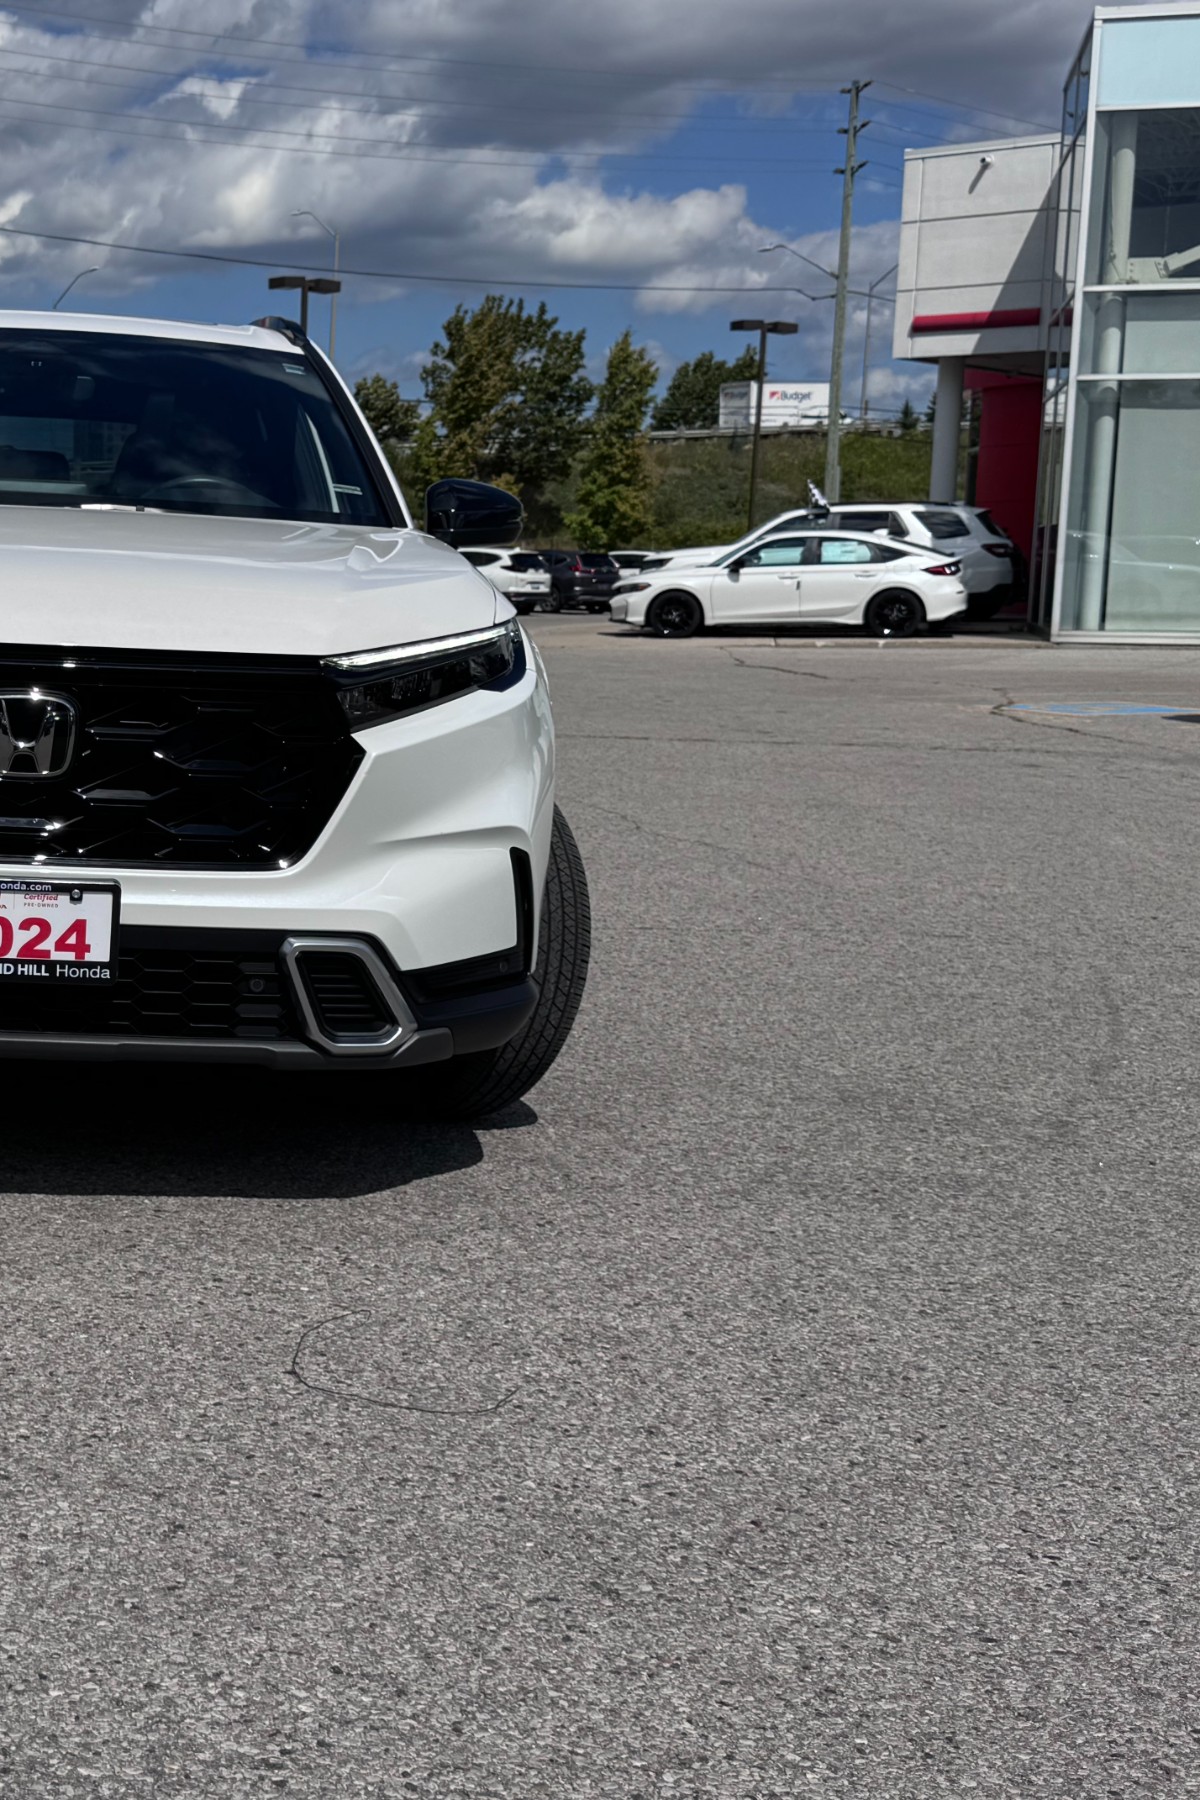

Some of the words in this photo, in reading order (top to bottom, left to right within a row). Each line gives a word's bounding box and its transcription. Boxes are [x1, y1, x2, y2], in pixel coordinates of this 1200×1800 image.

[781, 390, 812, 403] Budget
[24, 893, 59, 902] Certified
[17, 964, 49, 976] HILL
[56, 965, 111, 979] Honda
